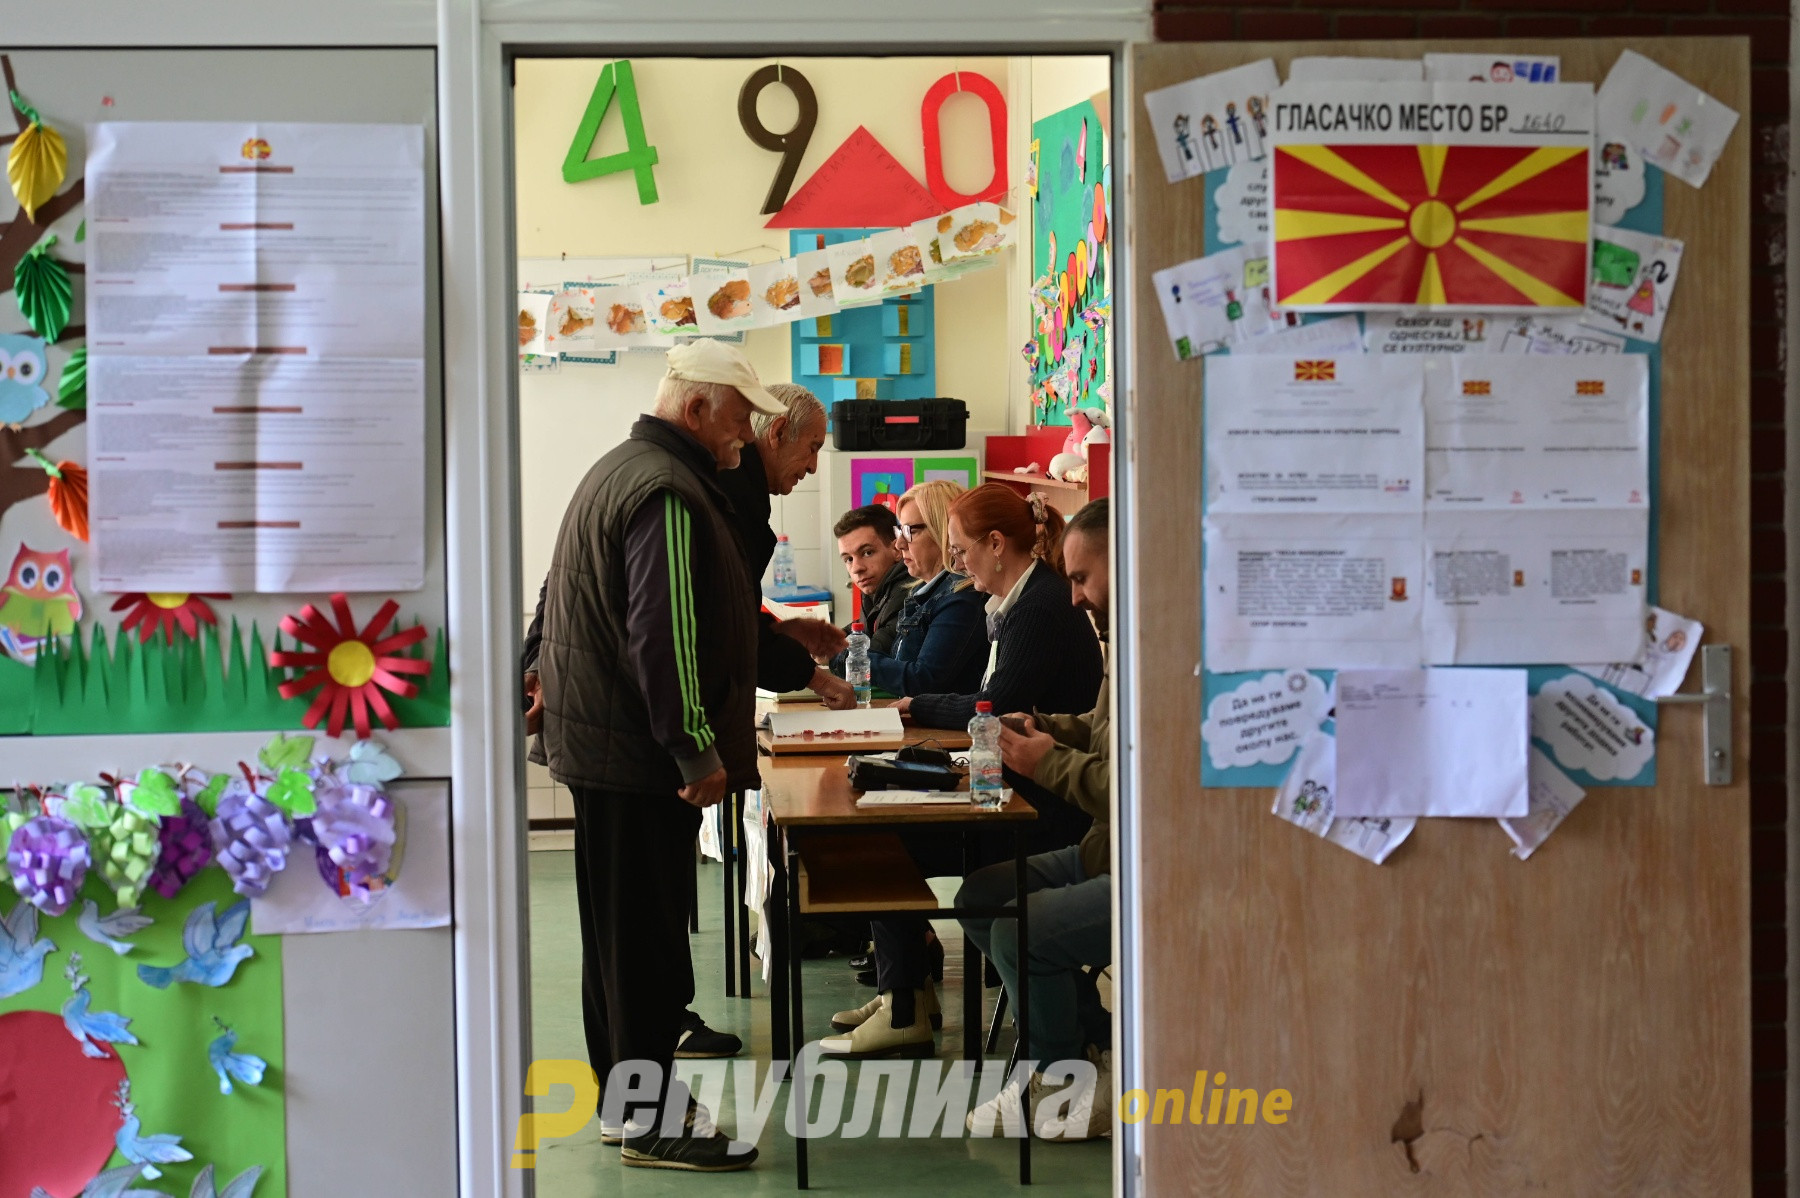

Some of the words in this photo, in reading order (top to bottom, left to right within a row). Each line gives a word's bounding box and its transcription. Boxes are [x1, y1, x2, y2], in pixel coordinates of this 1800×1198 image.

[561, 59, 660, 206] 4
[737, 63, 819, 216] 9
[1276, 103, 1392, 132] ГЛАСАЧКО
[1399, 104, 1474, 132] МЕСТО
